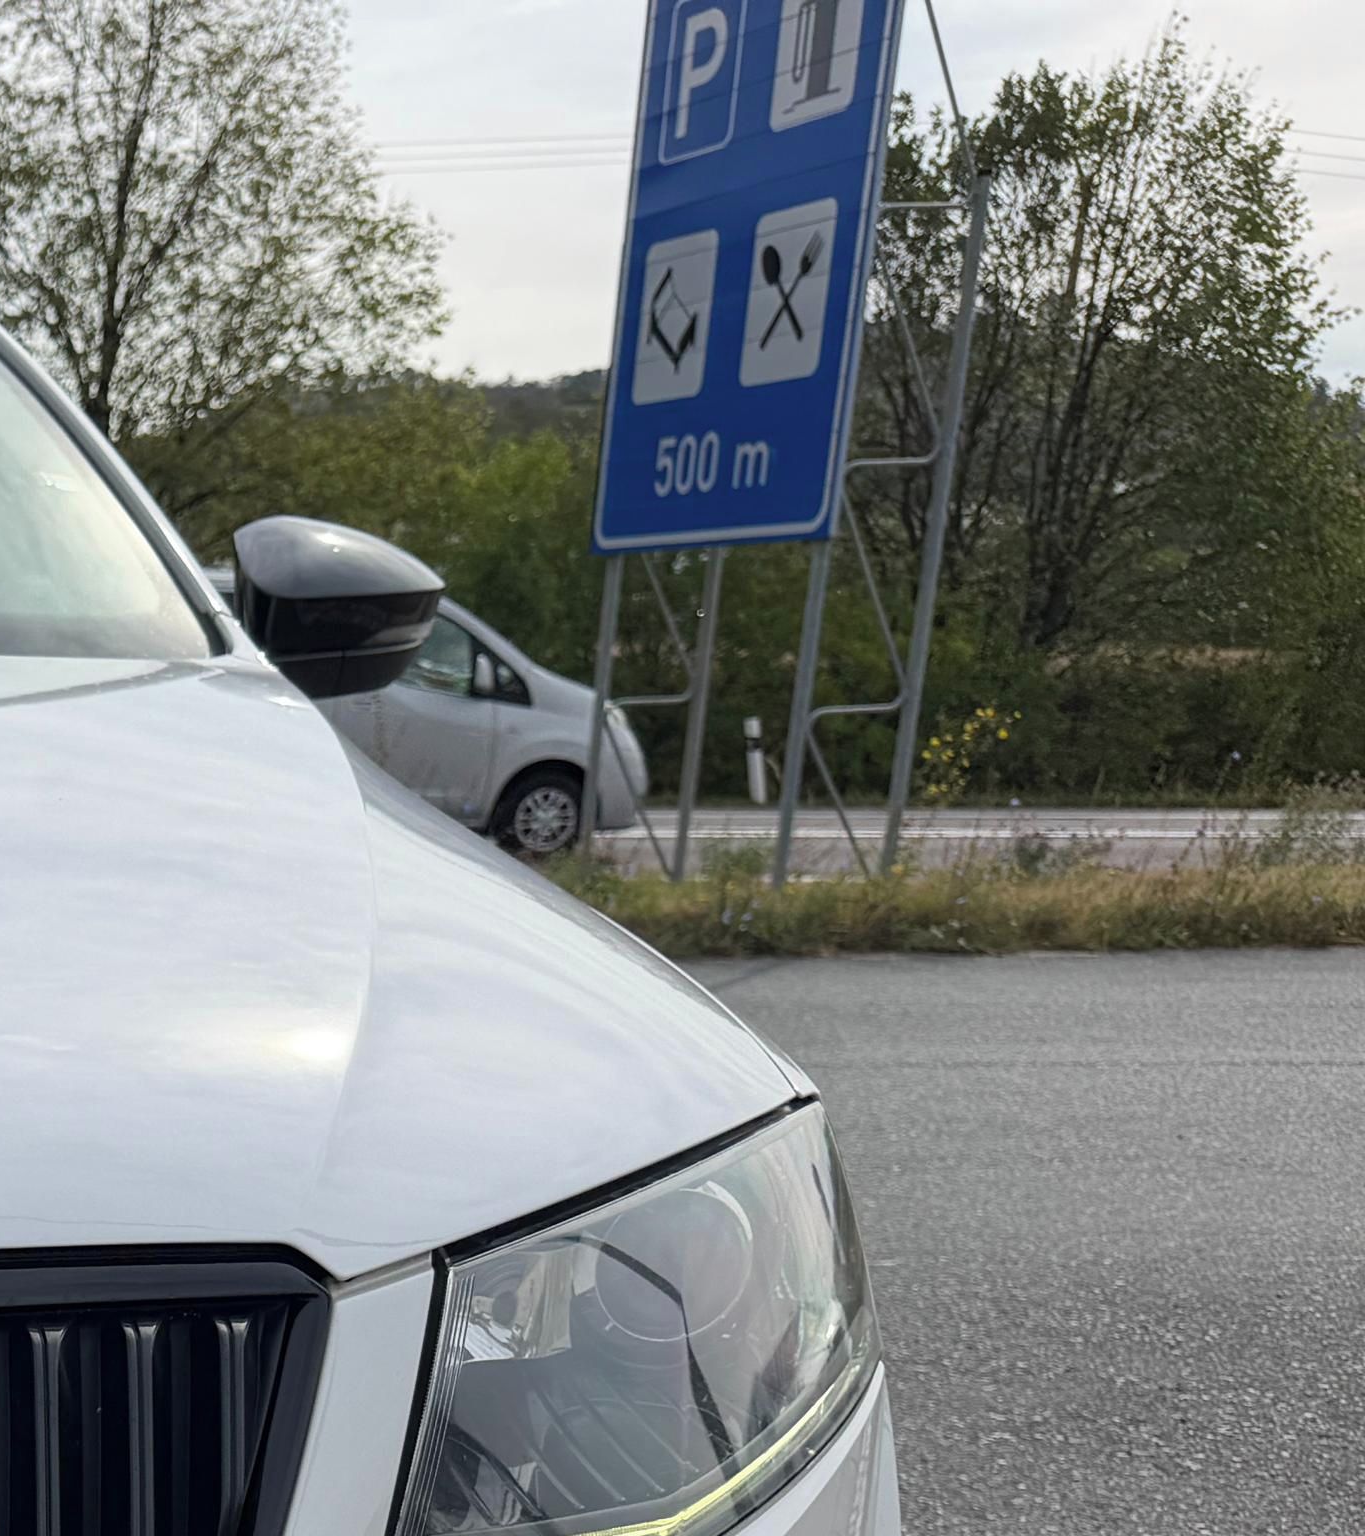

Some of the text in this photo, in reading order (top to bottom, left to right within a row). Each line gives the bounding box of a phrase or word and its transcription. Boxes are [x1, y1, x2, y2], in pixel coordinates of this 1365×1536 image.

[673, 6, 729, 140] P
[654, 430, 769, 497] 500 m
